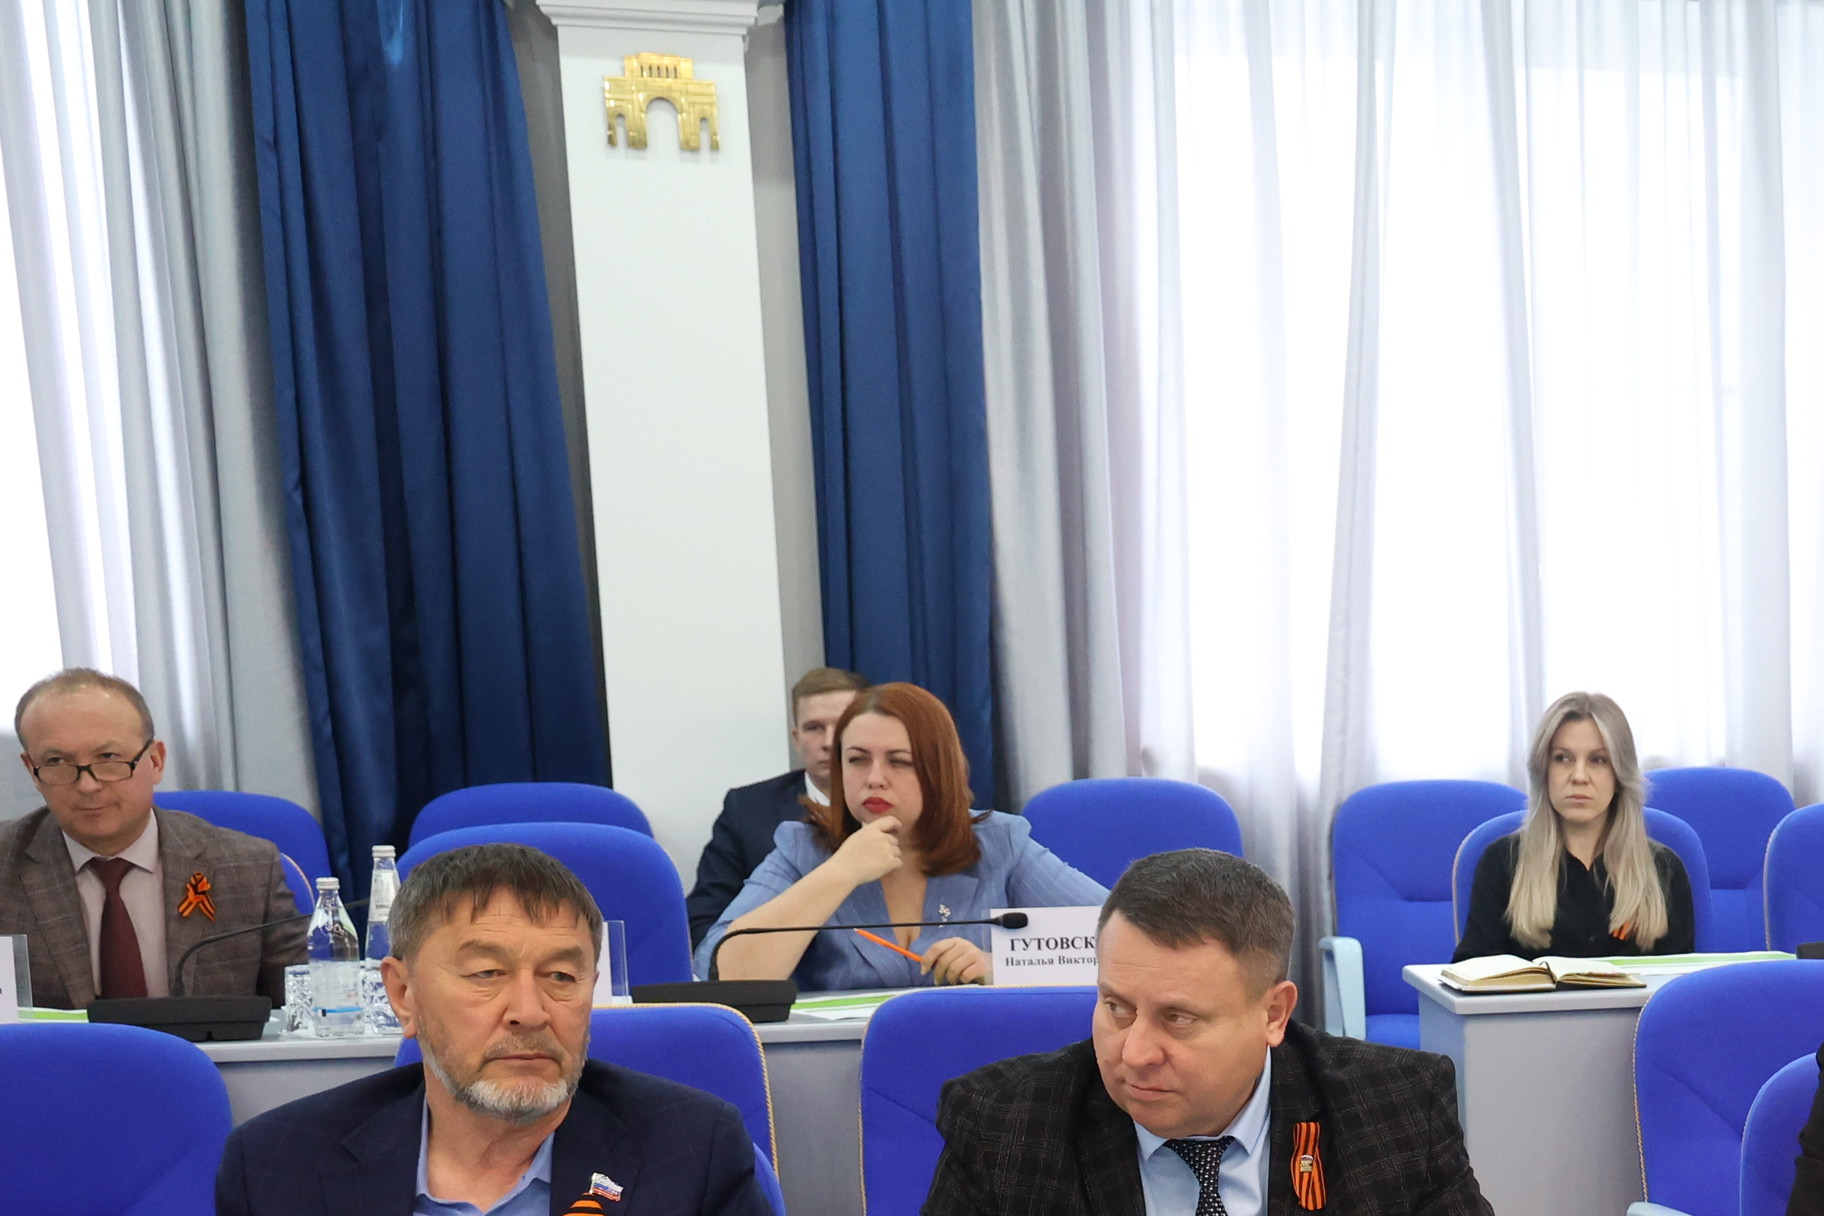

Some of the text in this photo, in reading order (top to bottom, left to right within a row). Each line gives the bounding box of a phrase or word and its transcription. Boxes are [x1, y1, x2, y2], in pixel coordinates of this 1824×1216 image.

[1009, 936, 1097, 952] ГУТОВСК
[1005, 955, 1099, 967] Наталья Виктор
